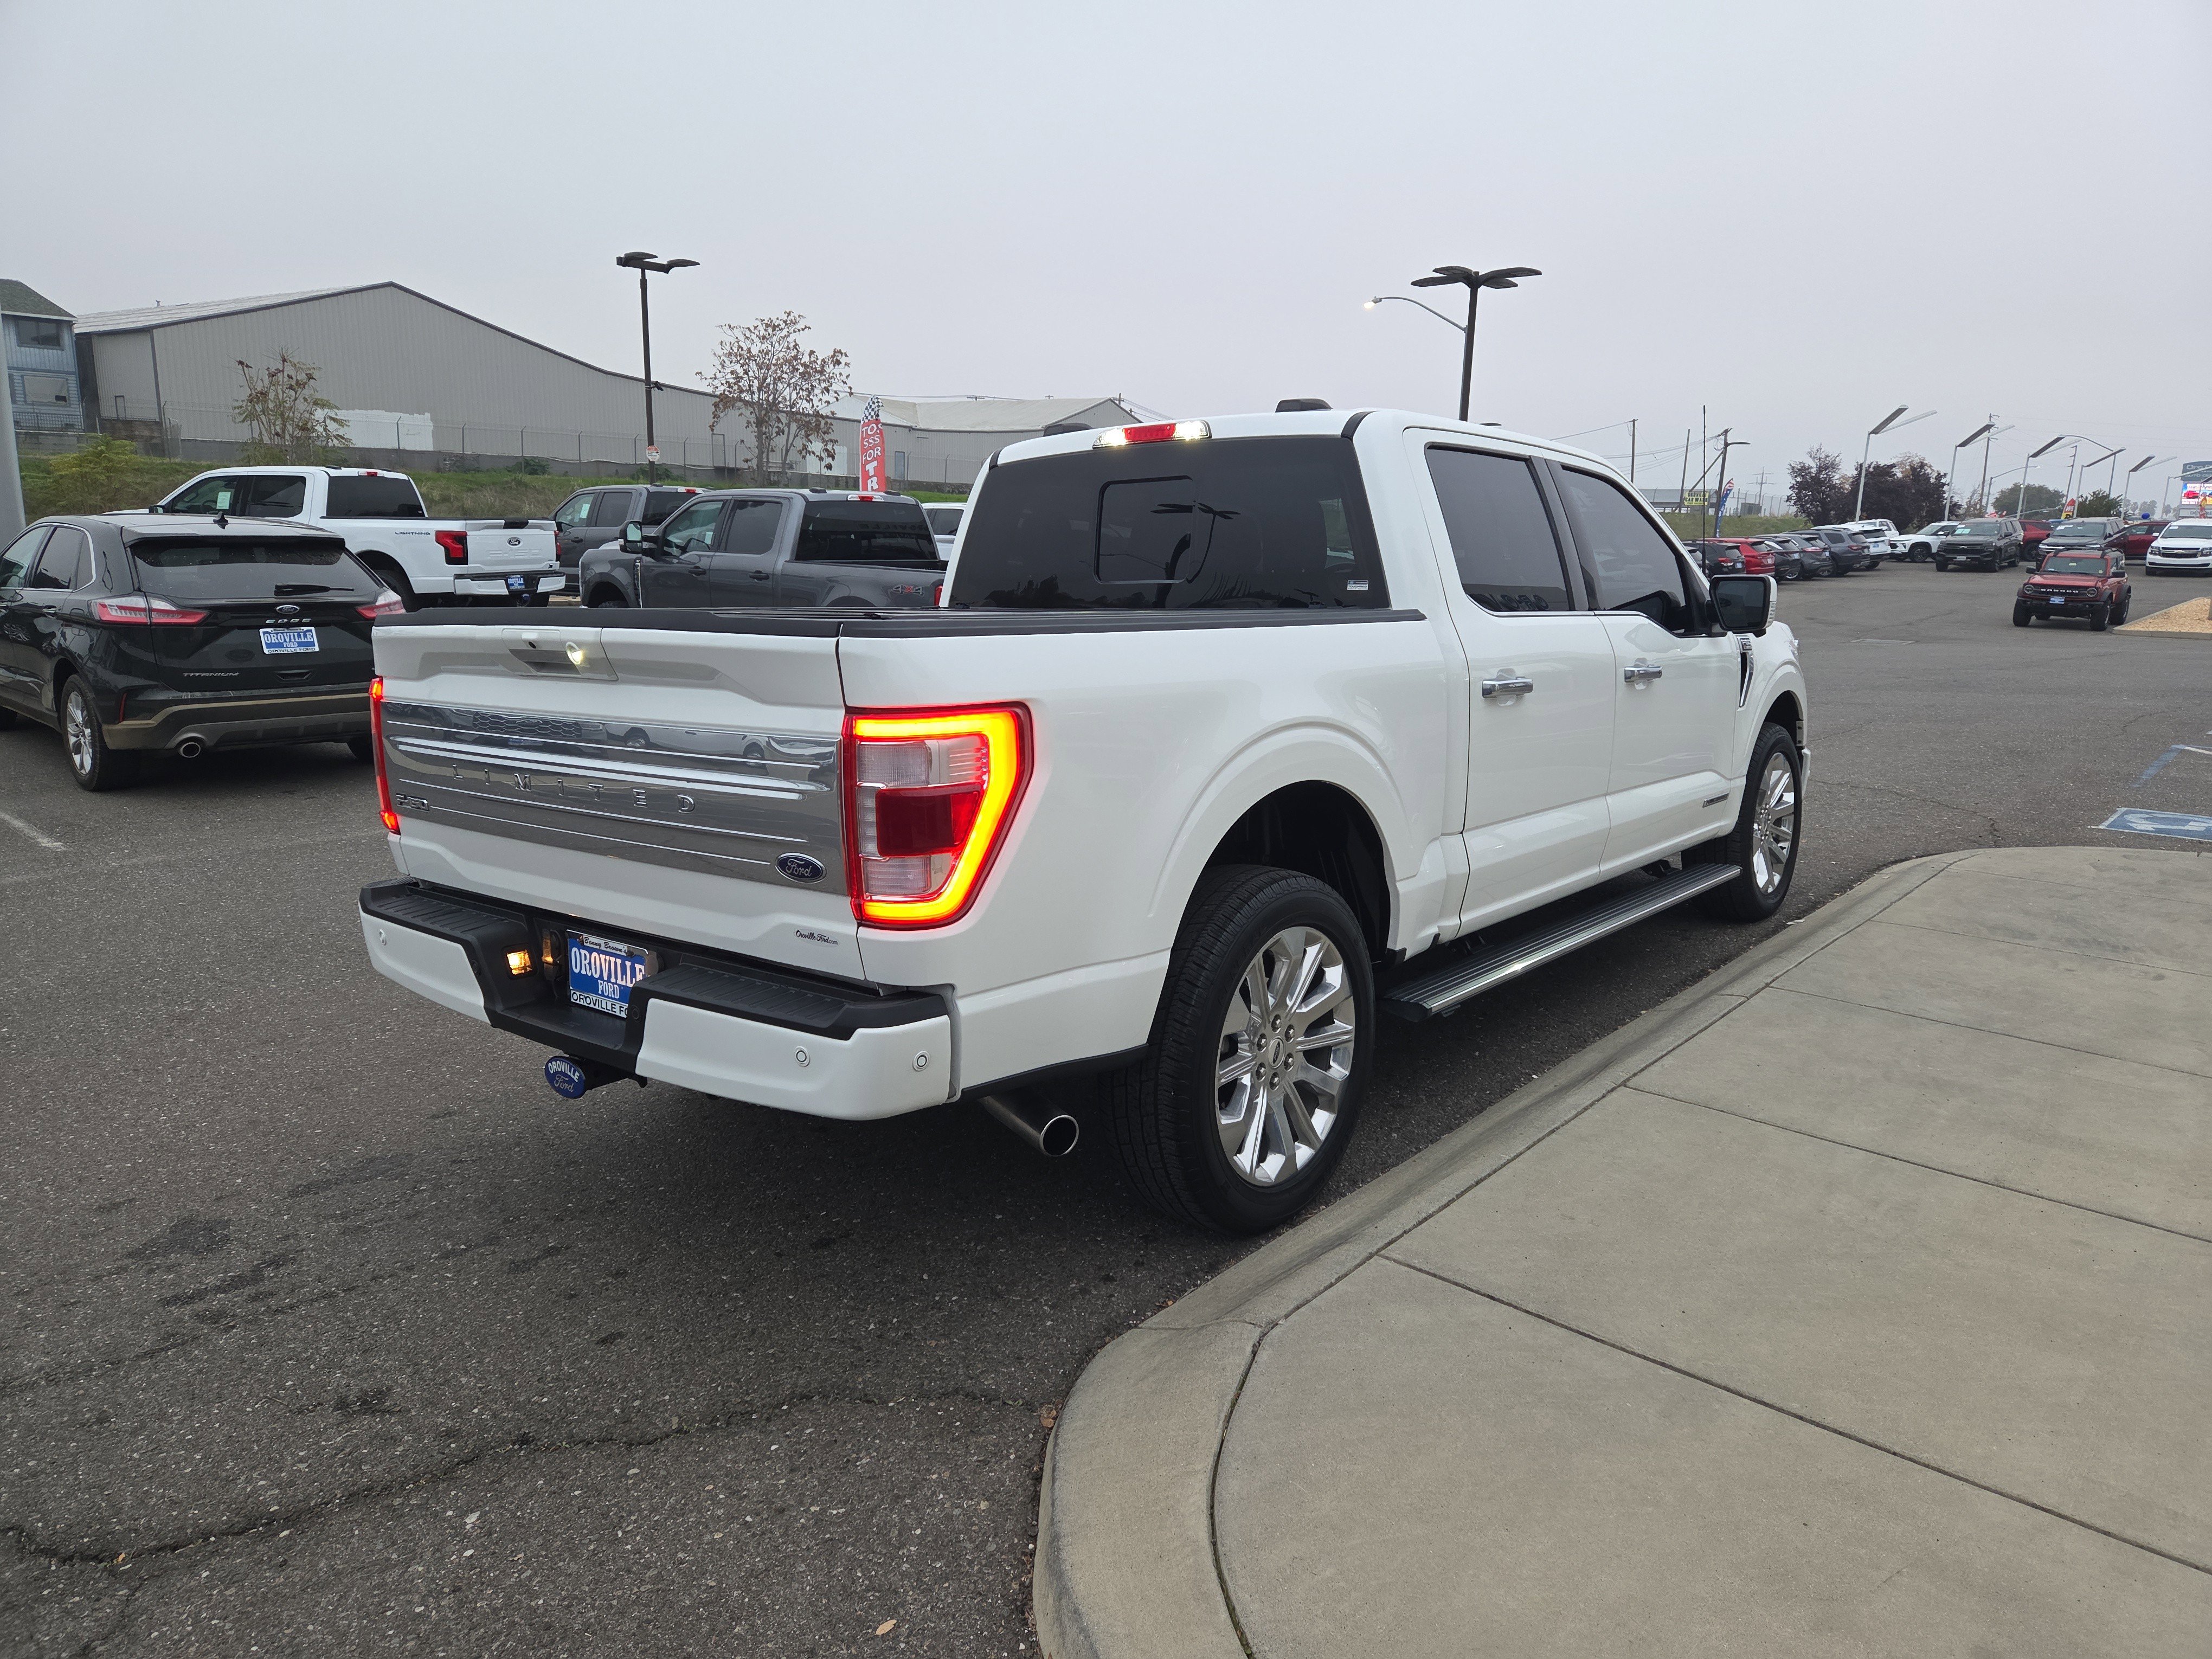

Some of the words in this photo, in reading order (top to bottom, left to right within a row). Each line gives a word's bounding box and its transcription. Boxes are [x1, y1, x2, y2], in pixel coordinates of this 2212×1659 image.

[863, 446, 881, 465] FOR
[264, 632, 314, 644] OROVILLE
[452, 764, 696, 813] LIMITED
[786, 858, 813, 877] Ford
[583, 936, 602, 949] Benny
[571, 947, 645, 988] OROVILLE
[598, 980, 620, 999] FORD
[572, 992, 617, 1013] OROVILLE
[548, 1060, 580, 1083] OROVILLE
[554, 1074, 575, 1092] Ford
